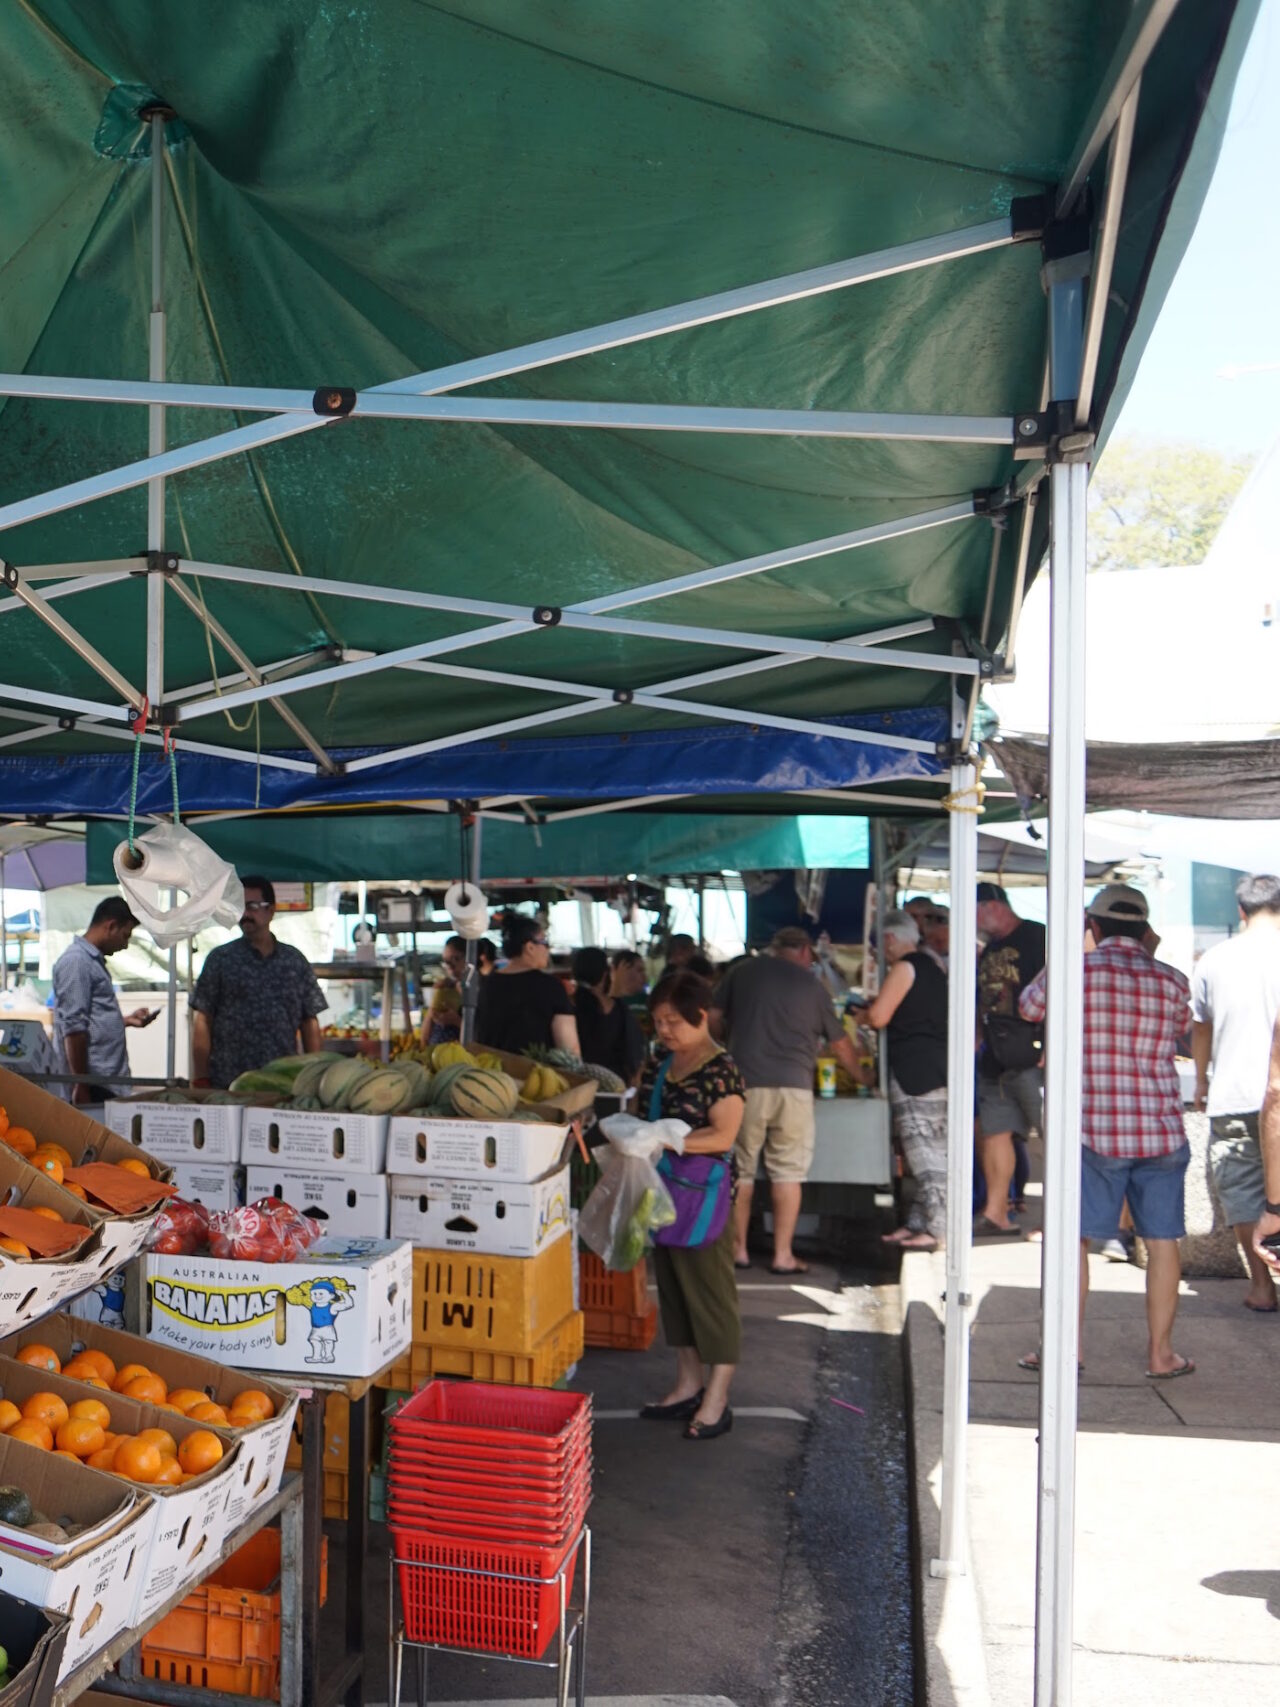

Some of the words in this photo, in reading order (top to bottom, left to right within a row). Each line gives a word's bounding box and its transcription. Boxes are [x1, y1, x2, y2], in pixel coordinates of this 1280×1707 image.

[451, 1202, 461, 1210] KG
[173, 1268, 261, 1282] AUSTRALIAN
[153, 1280, 281, 1326] BANANAS
[157, 1324, 188, 1345] Make
[188, 1336, 217, 1352] your
[219, 1335, 247, 1355] body
